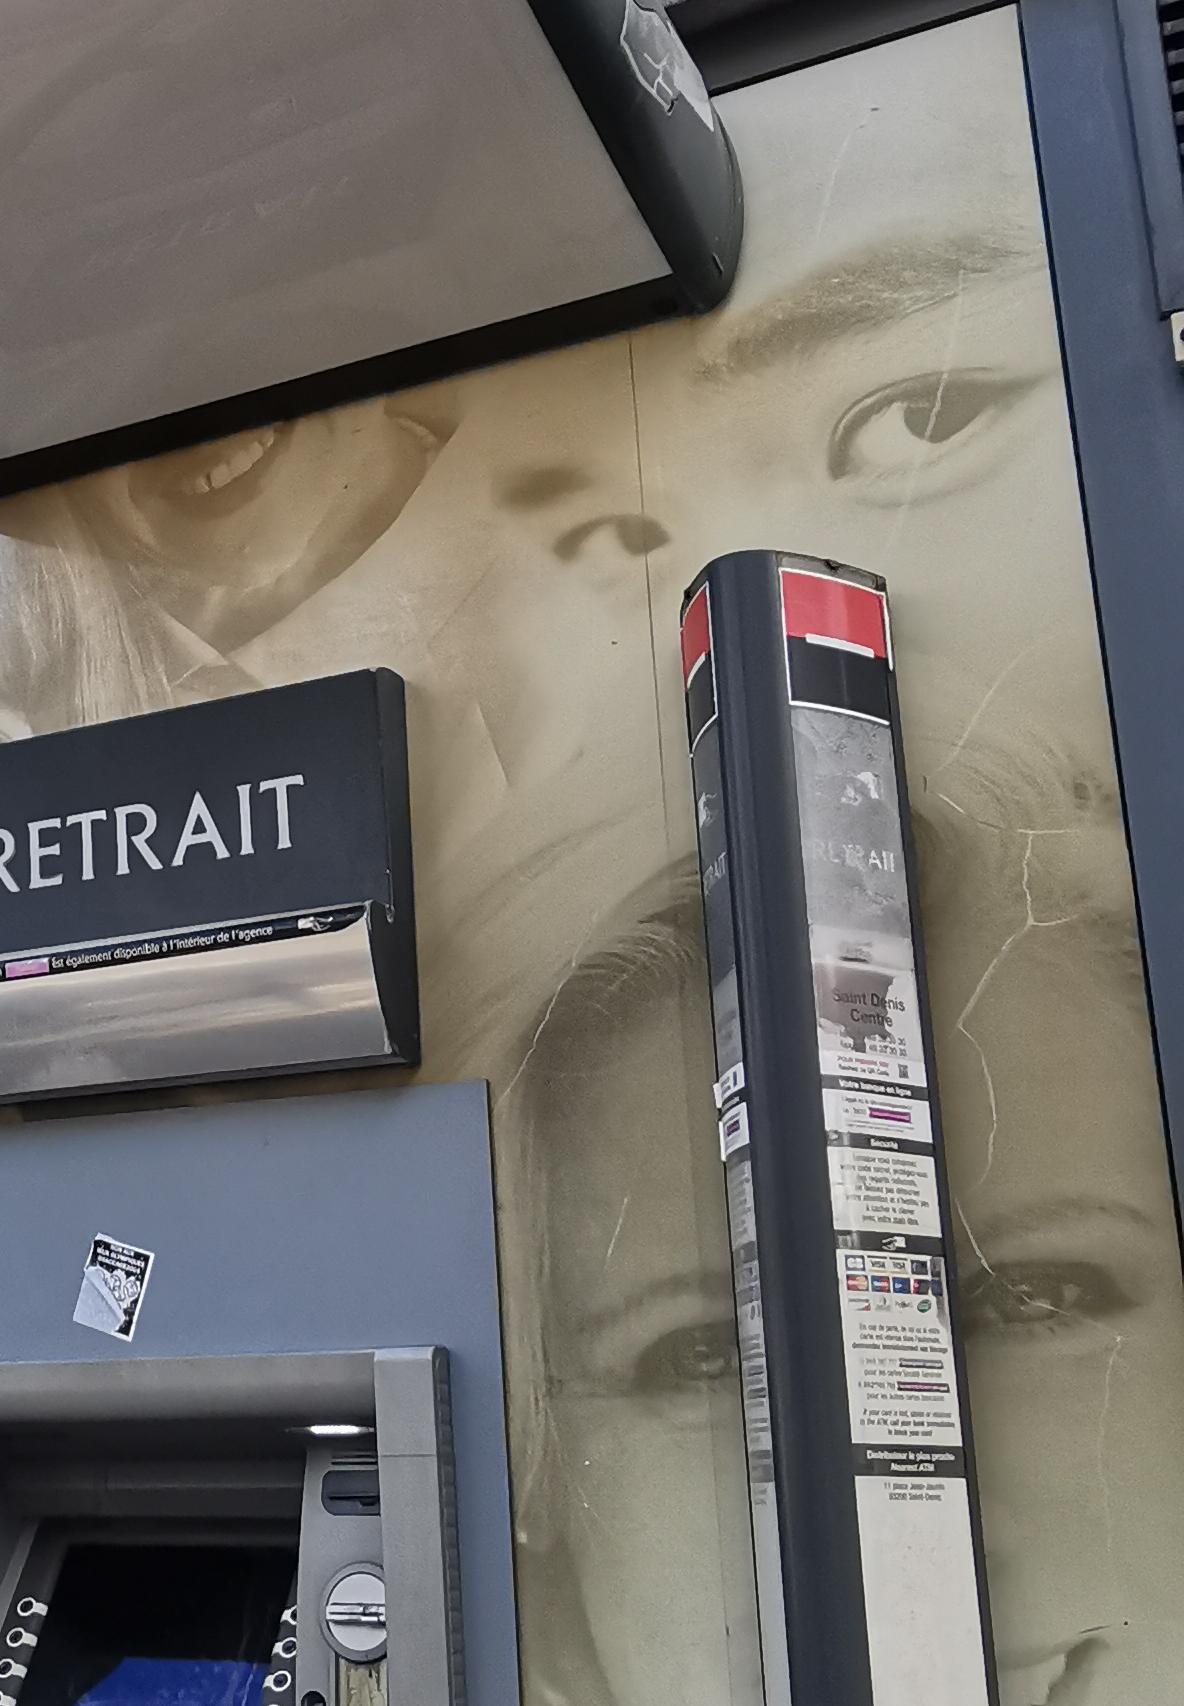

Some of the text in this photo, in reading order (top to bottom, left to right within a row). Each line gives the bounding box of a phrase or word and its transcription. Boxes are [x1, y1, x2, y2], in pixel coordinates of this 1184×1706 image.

[65, 949, 112, 969] également
[114, 943, 160, 961] disponible
[161, 940, 168, 953] à
[217, 931, 230, 943] de
[231, 926, 273, 942] l'agence
[833, 988, 906, 1012] Saint Denis
[850, 1008, 893, 1027] Centre
